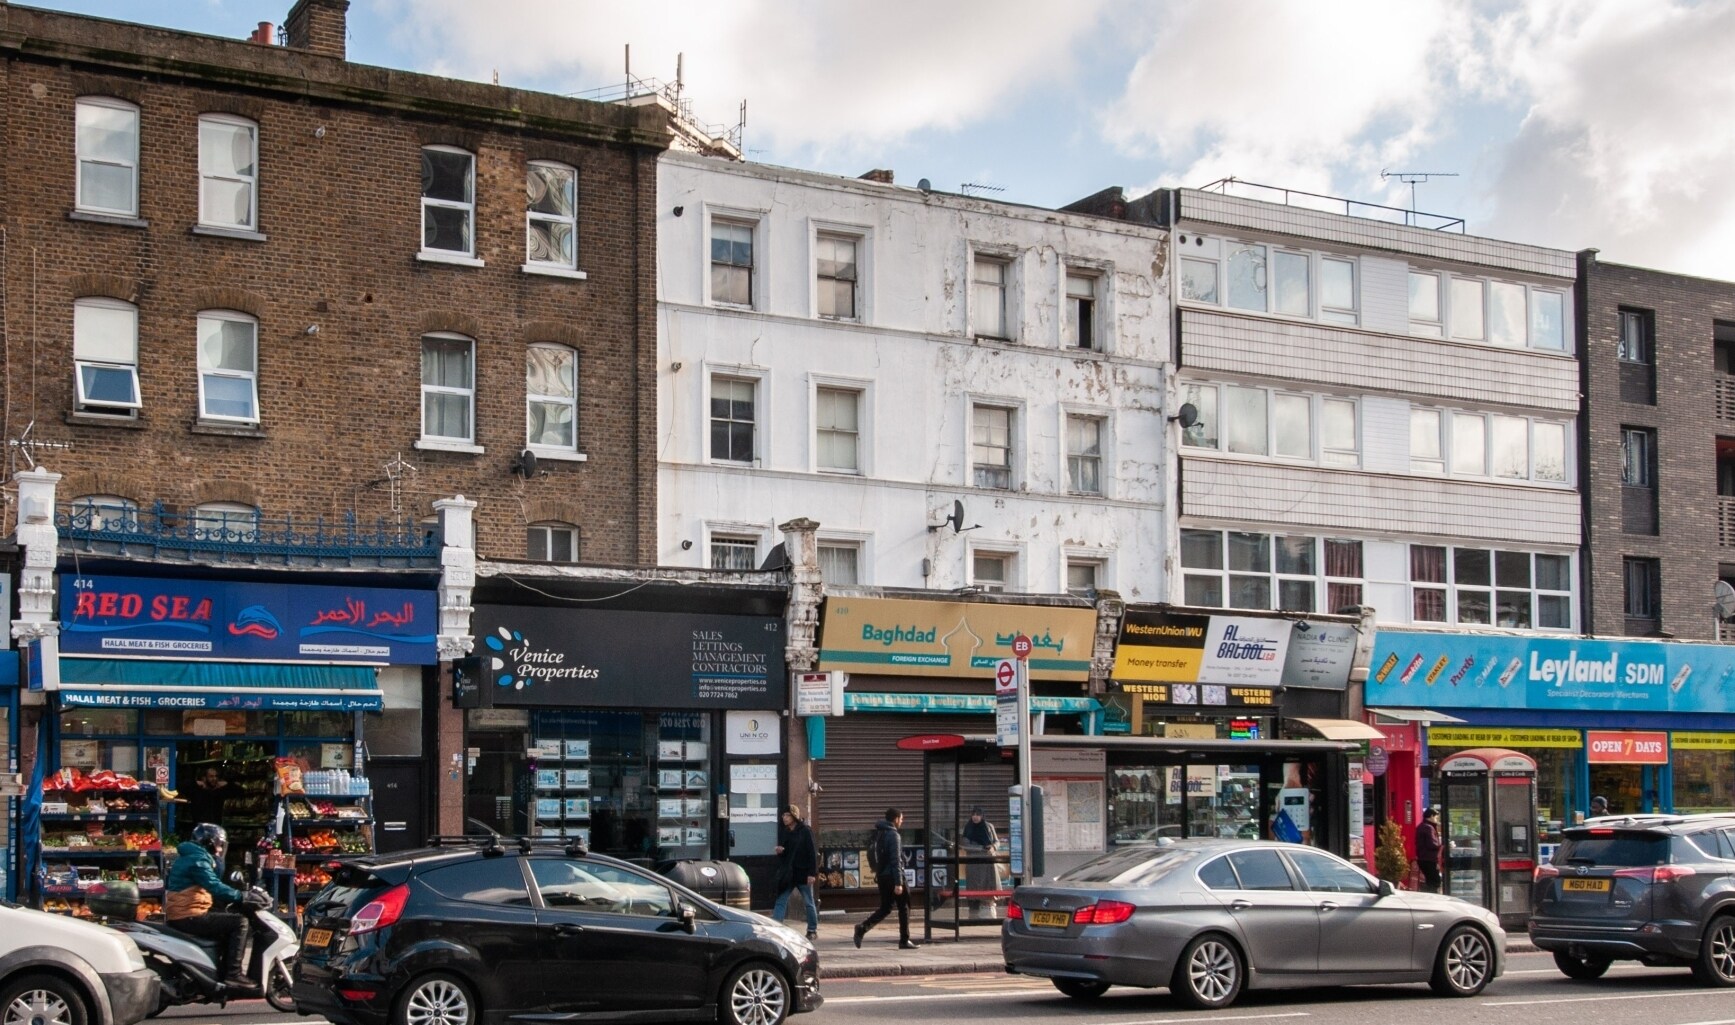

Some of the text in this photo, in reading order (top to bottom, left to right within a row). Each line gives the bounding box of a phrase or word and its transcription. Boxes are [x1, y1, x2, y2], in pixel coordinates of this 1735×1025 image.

[73, 579, 93, 589] 414
[73, 591, 213, 620] RED SEA
[309, 596, 414, 628] البحر الأحمر
[763, 623, 778, 632] 412
[1223, 624, 1239, 641] AL
[692, 630, 723, 640] SALES
[862, 624, 936, 646] Baghdad
[104, 639, 128, 648] HALAL
[154, 641, 170, 649] FISH
[172, 642, 210, 650] GROCERIES
[692, 641, 743, 651] LETTINGS
[1016, 642, 1029, 651] EB
[509, 647, 565, 664] Venice
[692, 652, 767, 663] MANAGEMENT
[918, 656, 948, 664] EXCHANGE
[692, 662, 768, 673] CONTRACTORS
[1127, 658, 1188, 668] Money transfer
[1528, 650, 1618, 687] Leyland
[1625, 662, 1665, 685] SDM
[517, 664, 600, 682] Properties
[1426, 657, 1447, 683] STANLEY
[1450, 655, 1475, 686] Purdy
[1122, 684, 1166, 694] WESTERN
[1231, 688, 1271, 697] WESTERN
[65, 694, 95, 704] HALAL
[96, 695, 122, 705] MEAT
[122, 695, 130, 705] &
[131, 696, 151, 705] FISH
[157, 697, 206, 706] GROCERIES
[1143, 693, 1166, 701] NION
[1243, 696, 1271, 704] UNION
[1592, 739, 1662, 755] OPEN 7 DAYS
